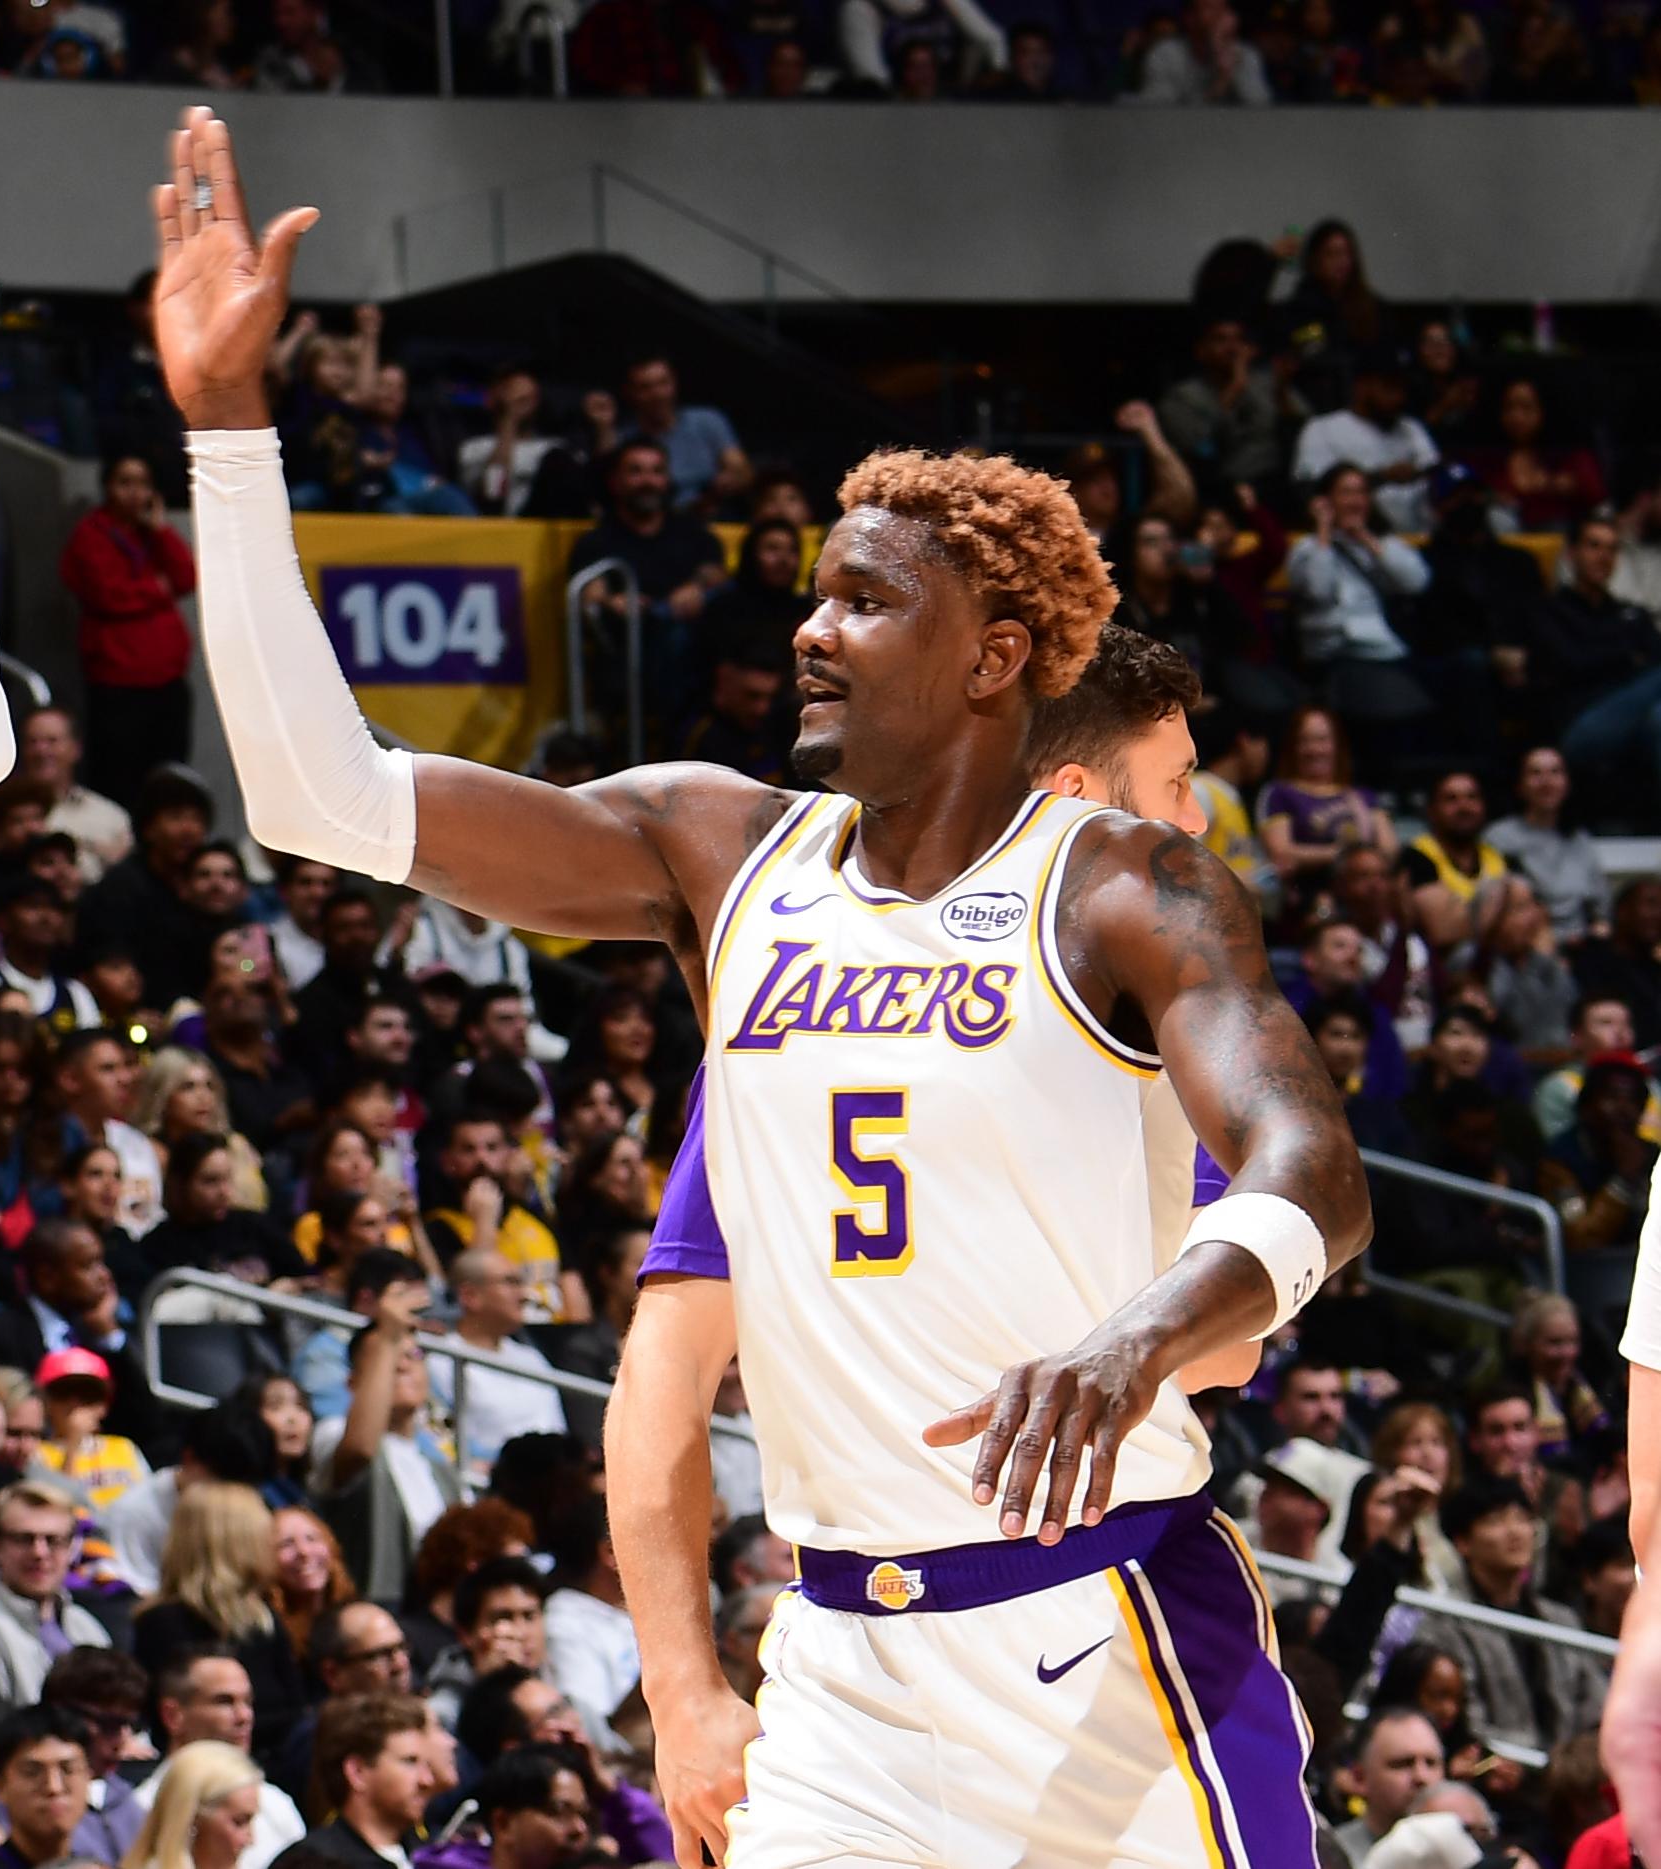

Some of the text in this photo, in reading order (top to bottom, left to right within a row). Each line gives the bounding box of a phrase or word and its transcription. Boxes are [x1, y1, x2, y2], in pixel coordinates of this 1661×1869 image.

[340, 582, 506, 668] 104
[950, 905, 1023, 927] bibigo
[725, 938, 1019, 1054] LAKERS
[829, 1085, 916, 1278] 5
